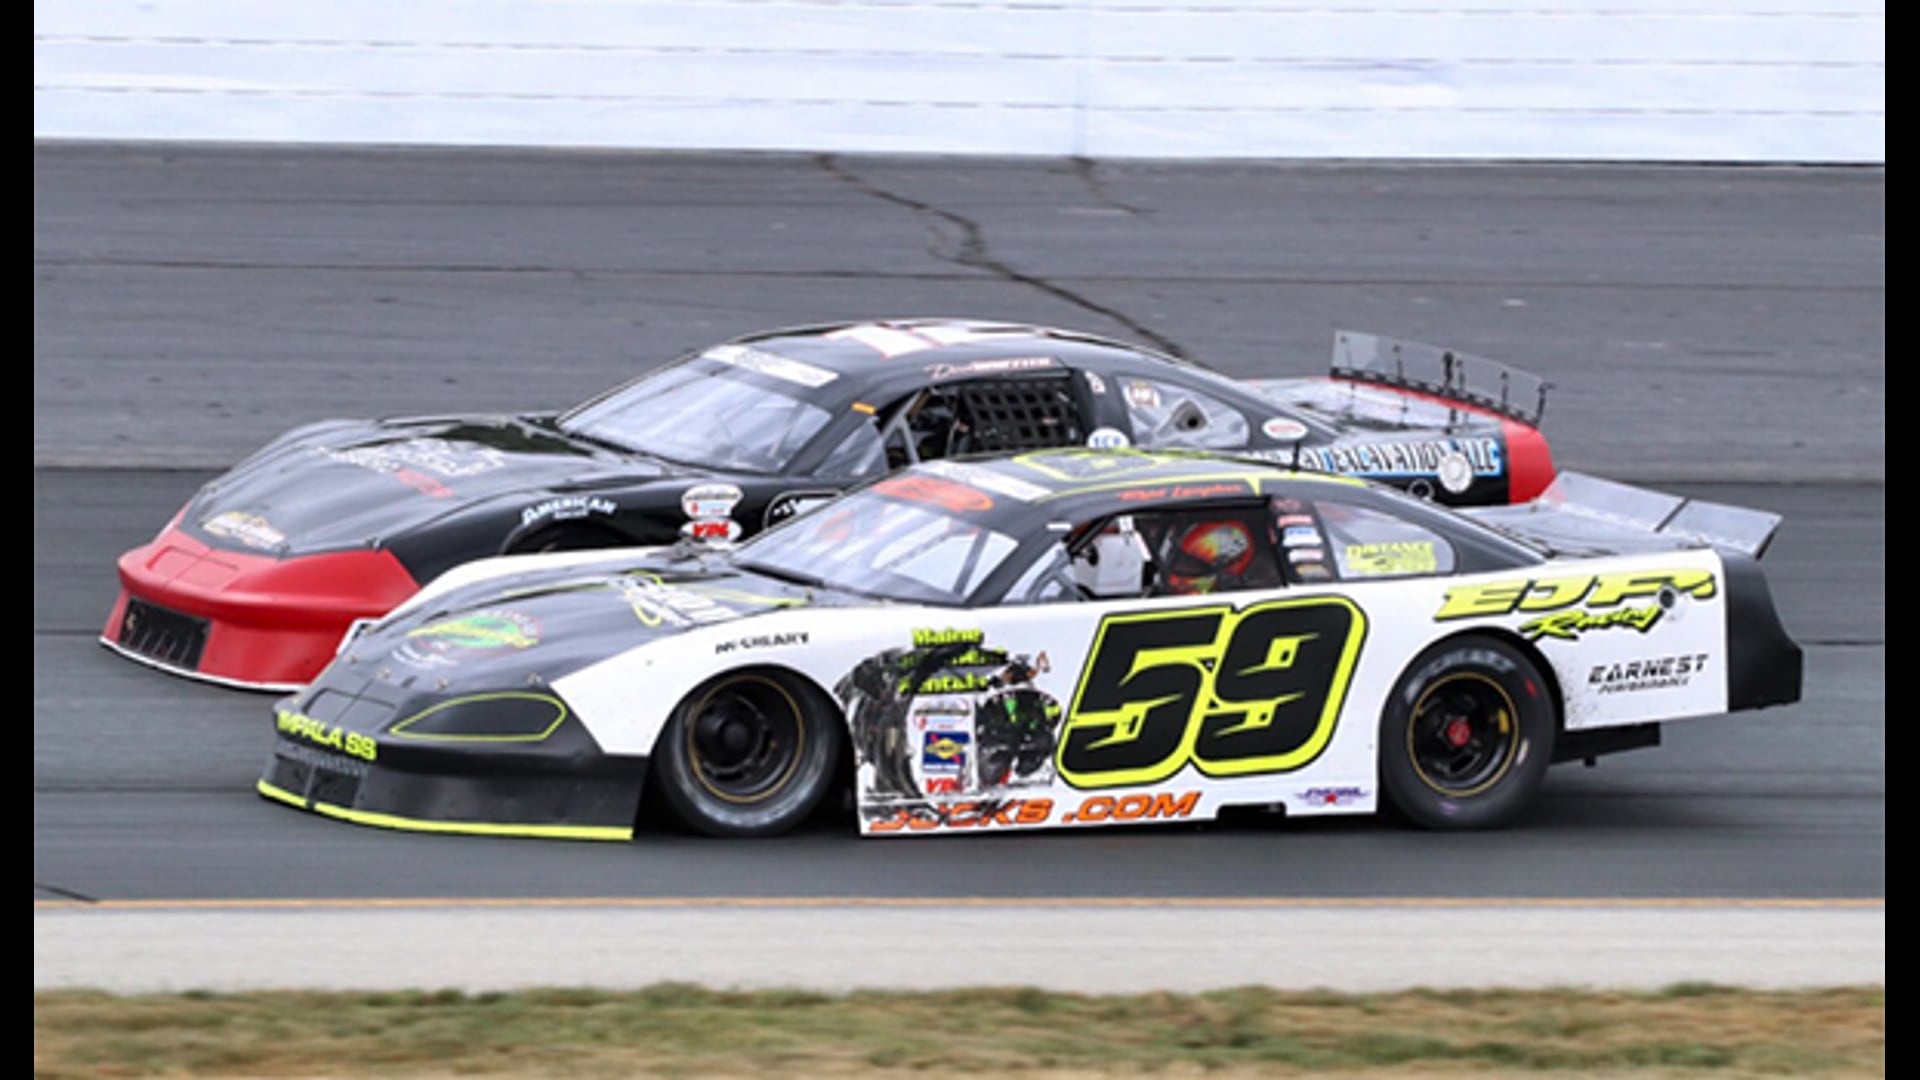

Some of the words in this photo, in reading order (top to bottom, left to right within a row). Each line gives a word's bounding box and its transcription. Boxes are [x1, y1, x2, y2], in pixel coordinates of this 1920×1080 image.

[522, 497, 617, 525] AMERICAN
[911, 627, 984, 649] Maine
[1519, 606, 1664, 641] Racing
[1588, 653, 1709, 683] EARNEST
[1055, 593, 1369, 790] 59
[1062, 792, 1203, 822] .COM
